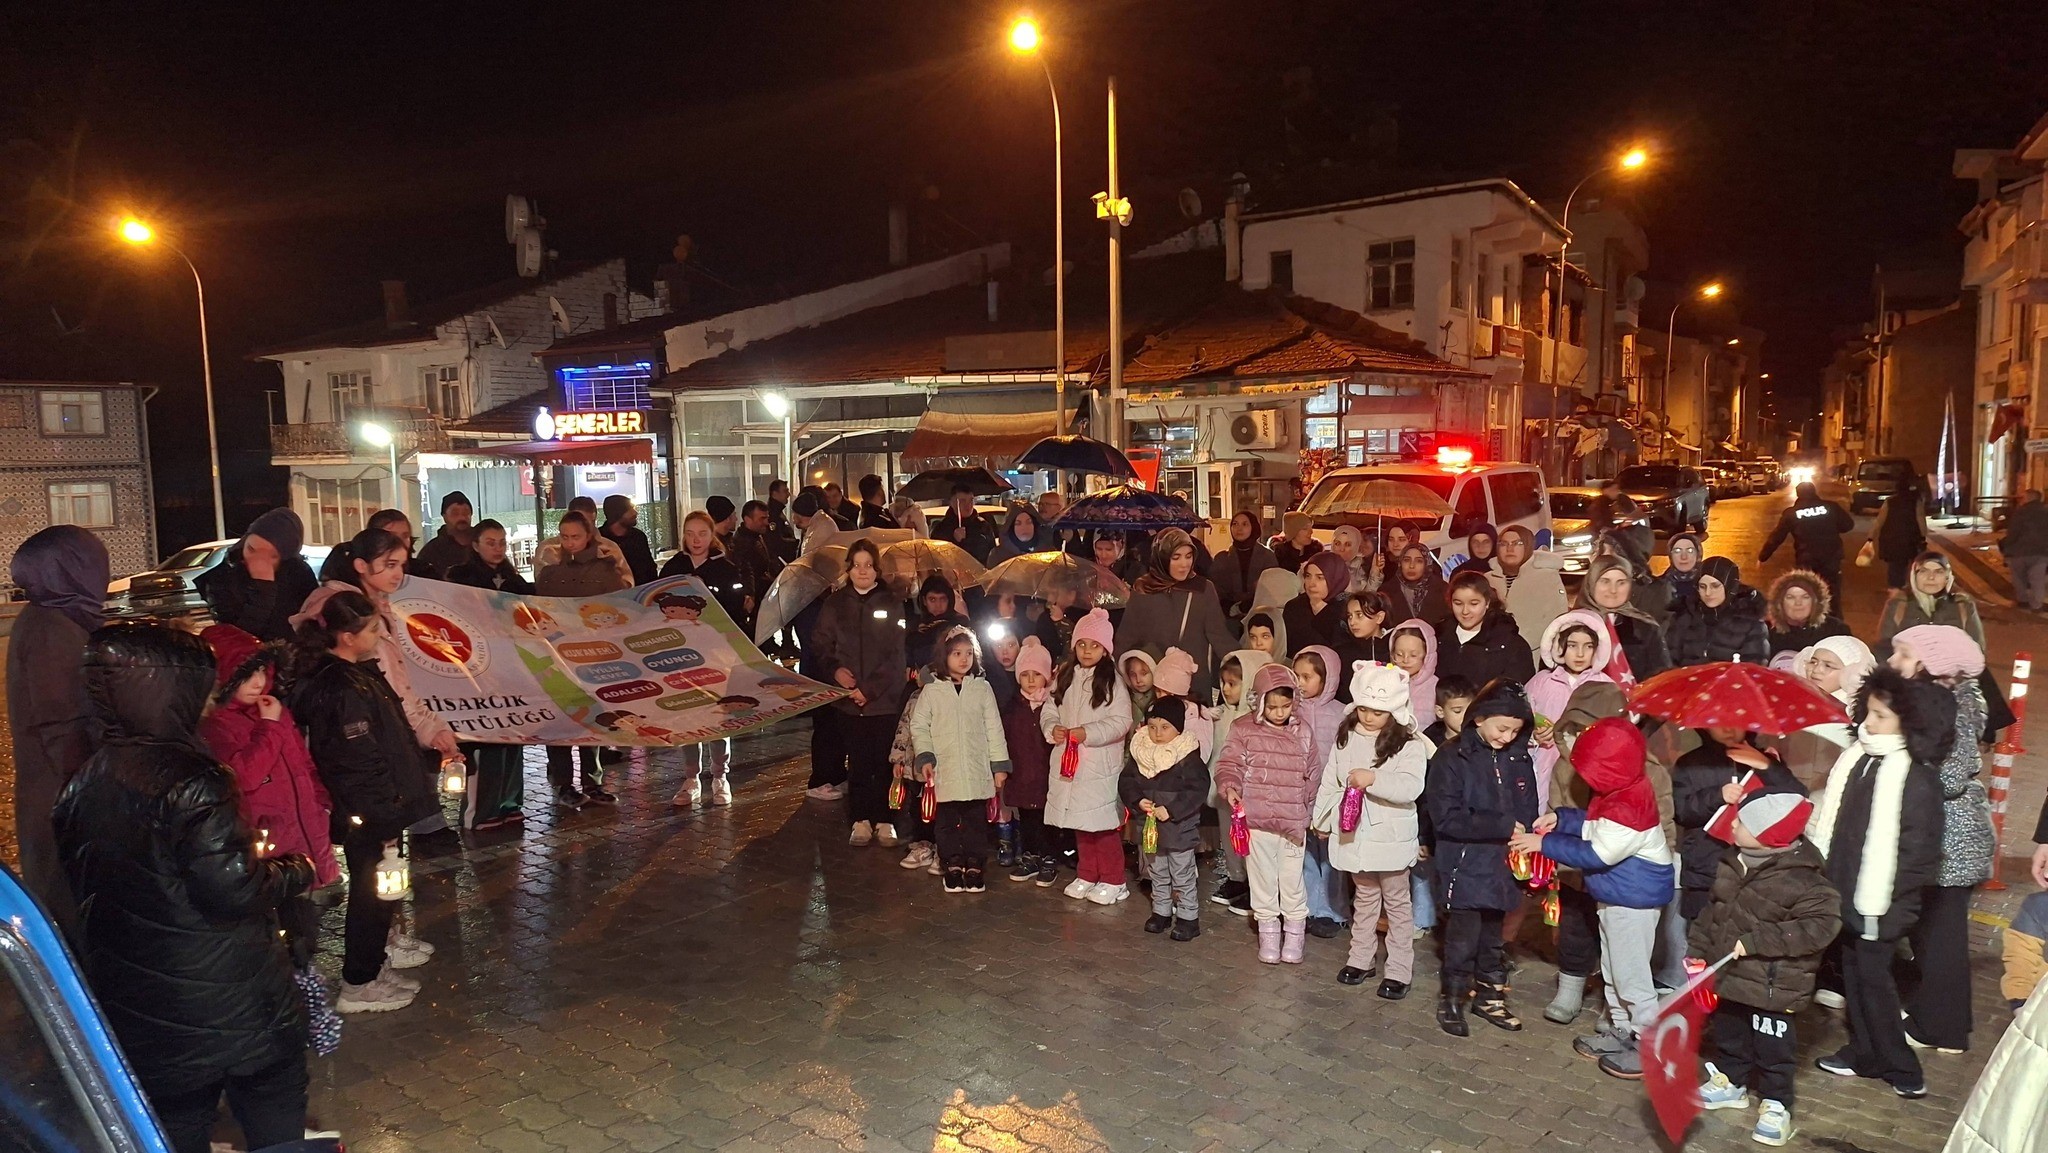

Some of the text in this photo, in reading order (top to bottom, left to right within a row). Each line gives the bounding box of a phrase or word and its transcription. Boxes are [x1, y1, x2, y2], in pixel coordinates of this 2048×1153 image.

[555, 411, 641, 440] ŞENERLER
[629, 632, 679, 649] MERHAMETLİ
[597, 644, 619, 655] EHLİ
[647, 652, 699, 668] OYUNCU
[588, 665, 622, 675] İYİLİK
[594, 671, 630, 681] SEVER
[602, 683, 657, 699] ADALETLİ
[721, 689, 845, 731] SEVİYORUM
[447, 708, 556, 733] FTÜLÜĞÜ
[1752, 1013, 1788, 1038] GAP
